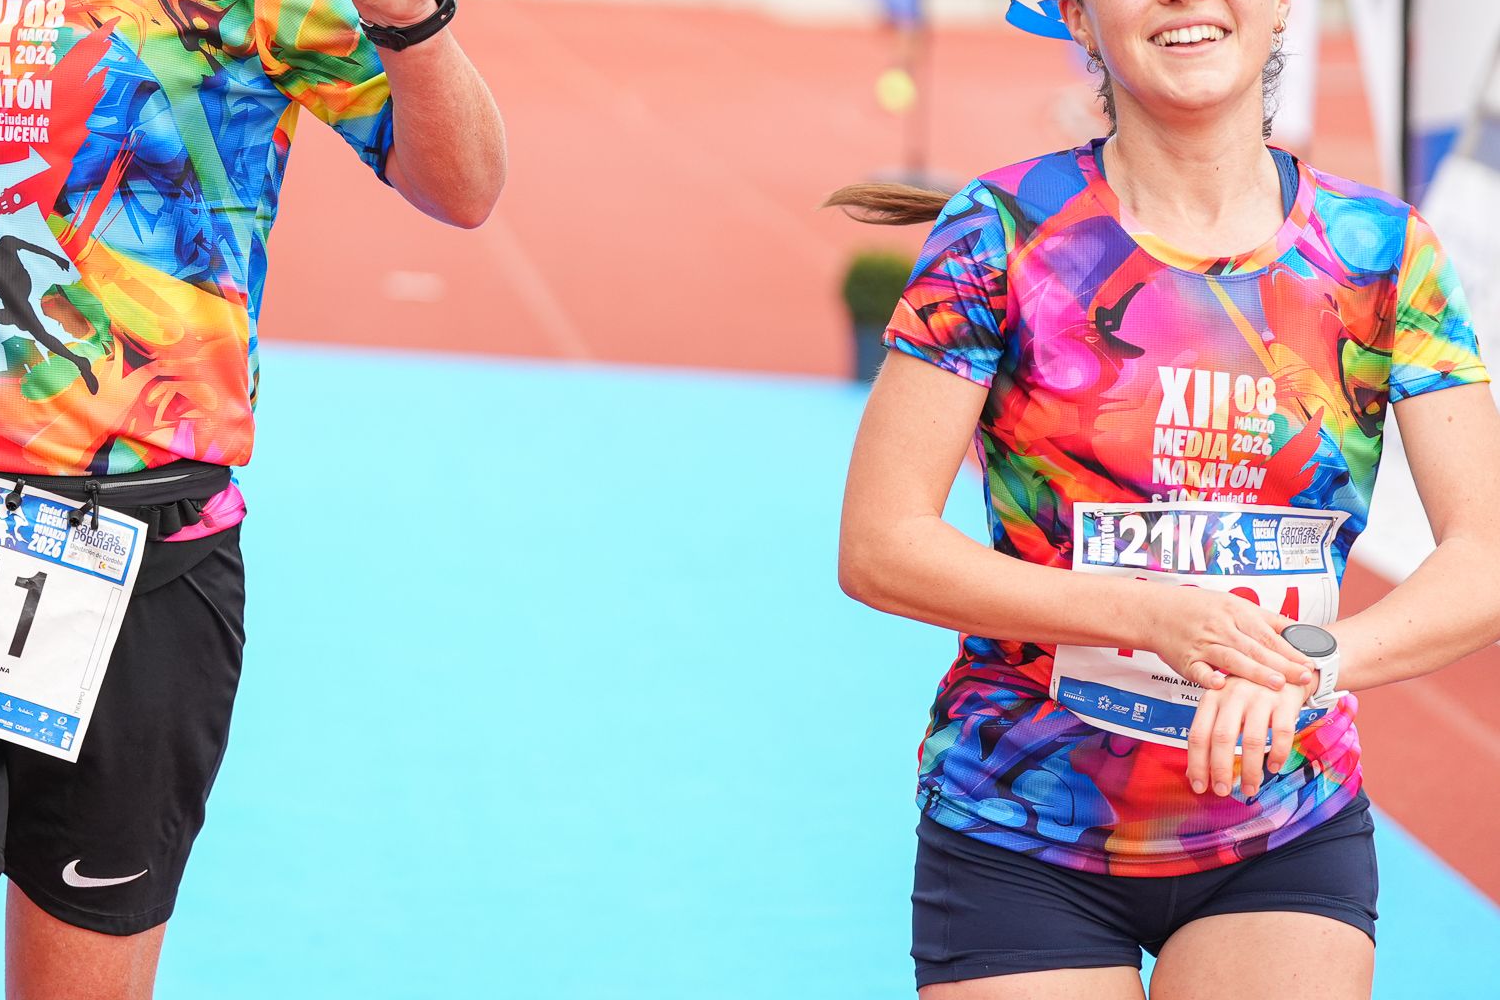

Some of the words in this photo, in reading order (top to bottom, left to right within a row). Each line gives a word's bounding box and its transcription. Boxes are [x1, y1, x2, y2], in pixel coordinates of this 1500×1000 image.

[17, 28, 59, 42] MARZO
[15, 45, 57, 65] 2026
[37, 114, 49, 127] de
[1155, 366, 1230, 430] XII
[1234, 374, 1277, 415] 08
[1234, 415, 1275, 434] MARZO
[1153, 427, 1228, 461] MEDIA
[1231, 433, 1273, 456] 2026
[1152, 457, 1267, 489] MARATÓN
[1212, 492, 1244, 503] Ciudad
[1246, 493, 1258, 503] de
[36, 512, 68, 531] LUCENA
[76, 524, 120, 545] carreras
[1281, 526, 1317, 537] carreras
[1281, 534, 1320, 548] populares
[28, 533, 62, 558] 2026
[72, 529, 127, 557] populares
[1119, 514, 1209, 571] 21K
[1255, 551, 1280, 570] 2026
[1151, 674, 1179, 686] MARÍA
[1181, 693, 1199, 701] TALL
